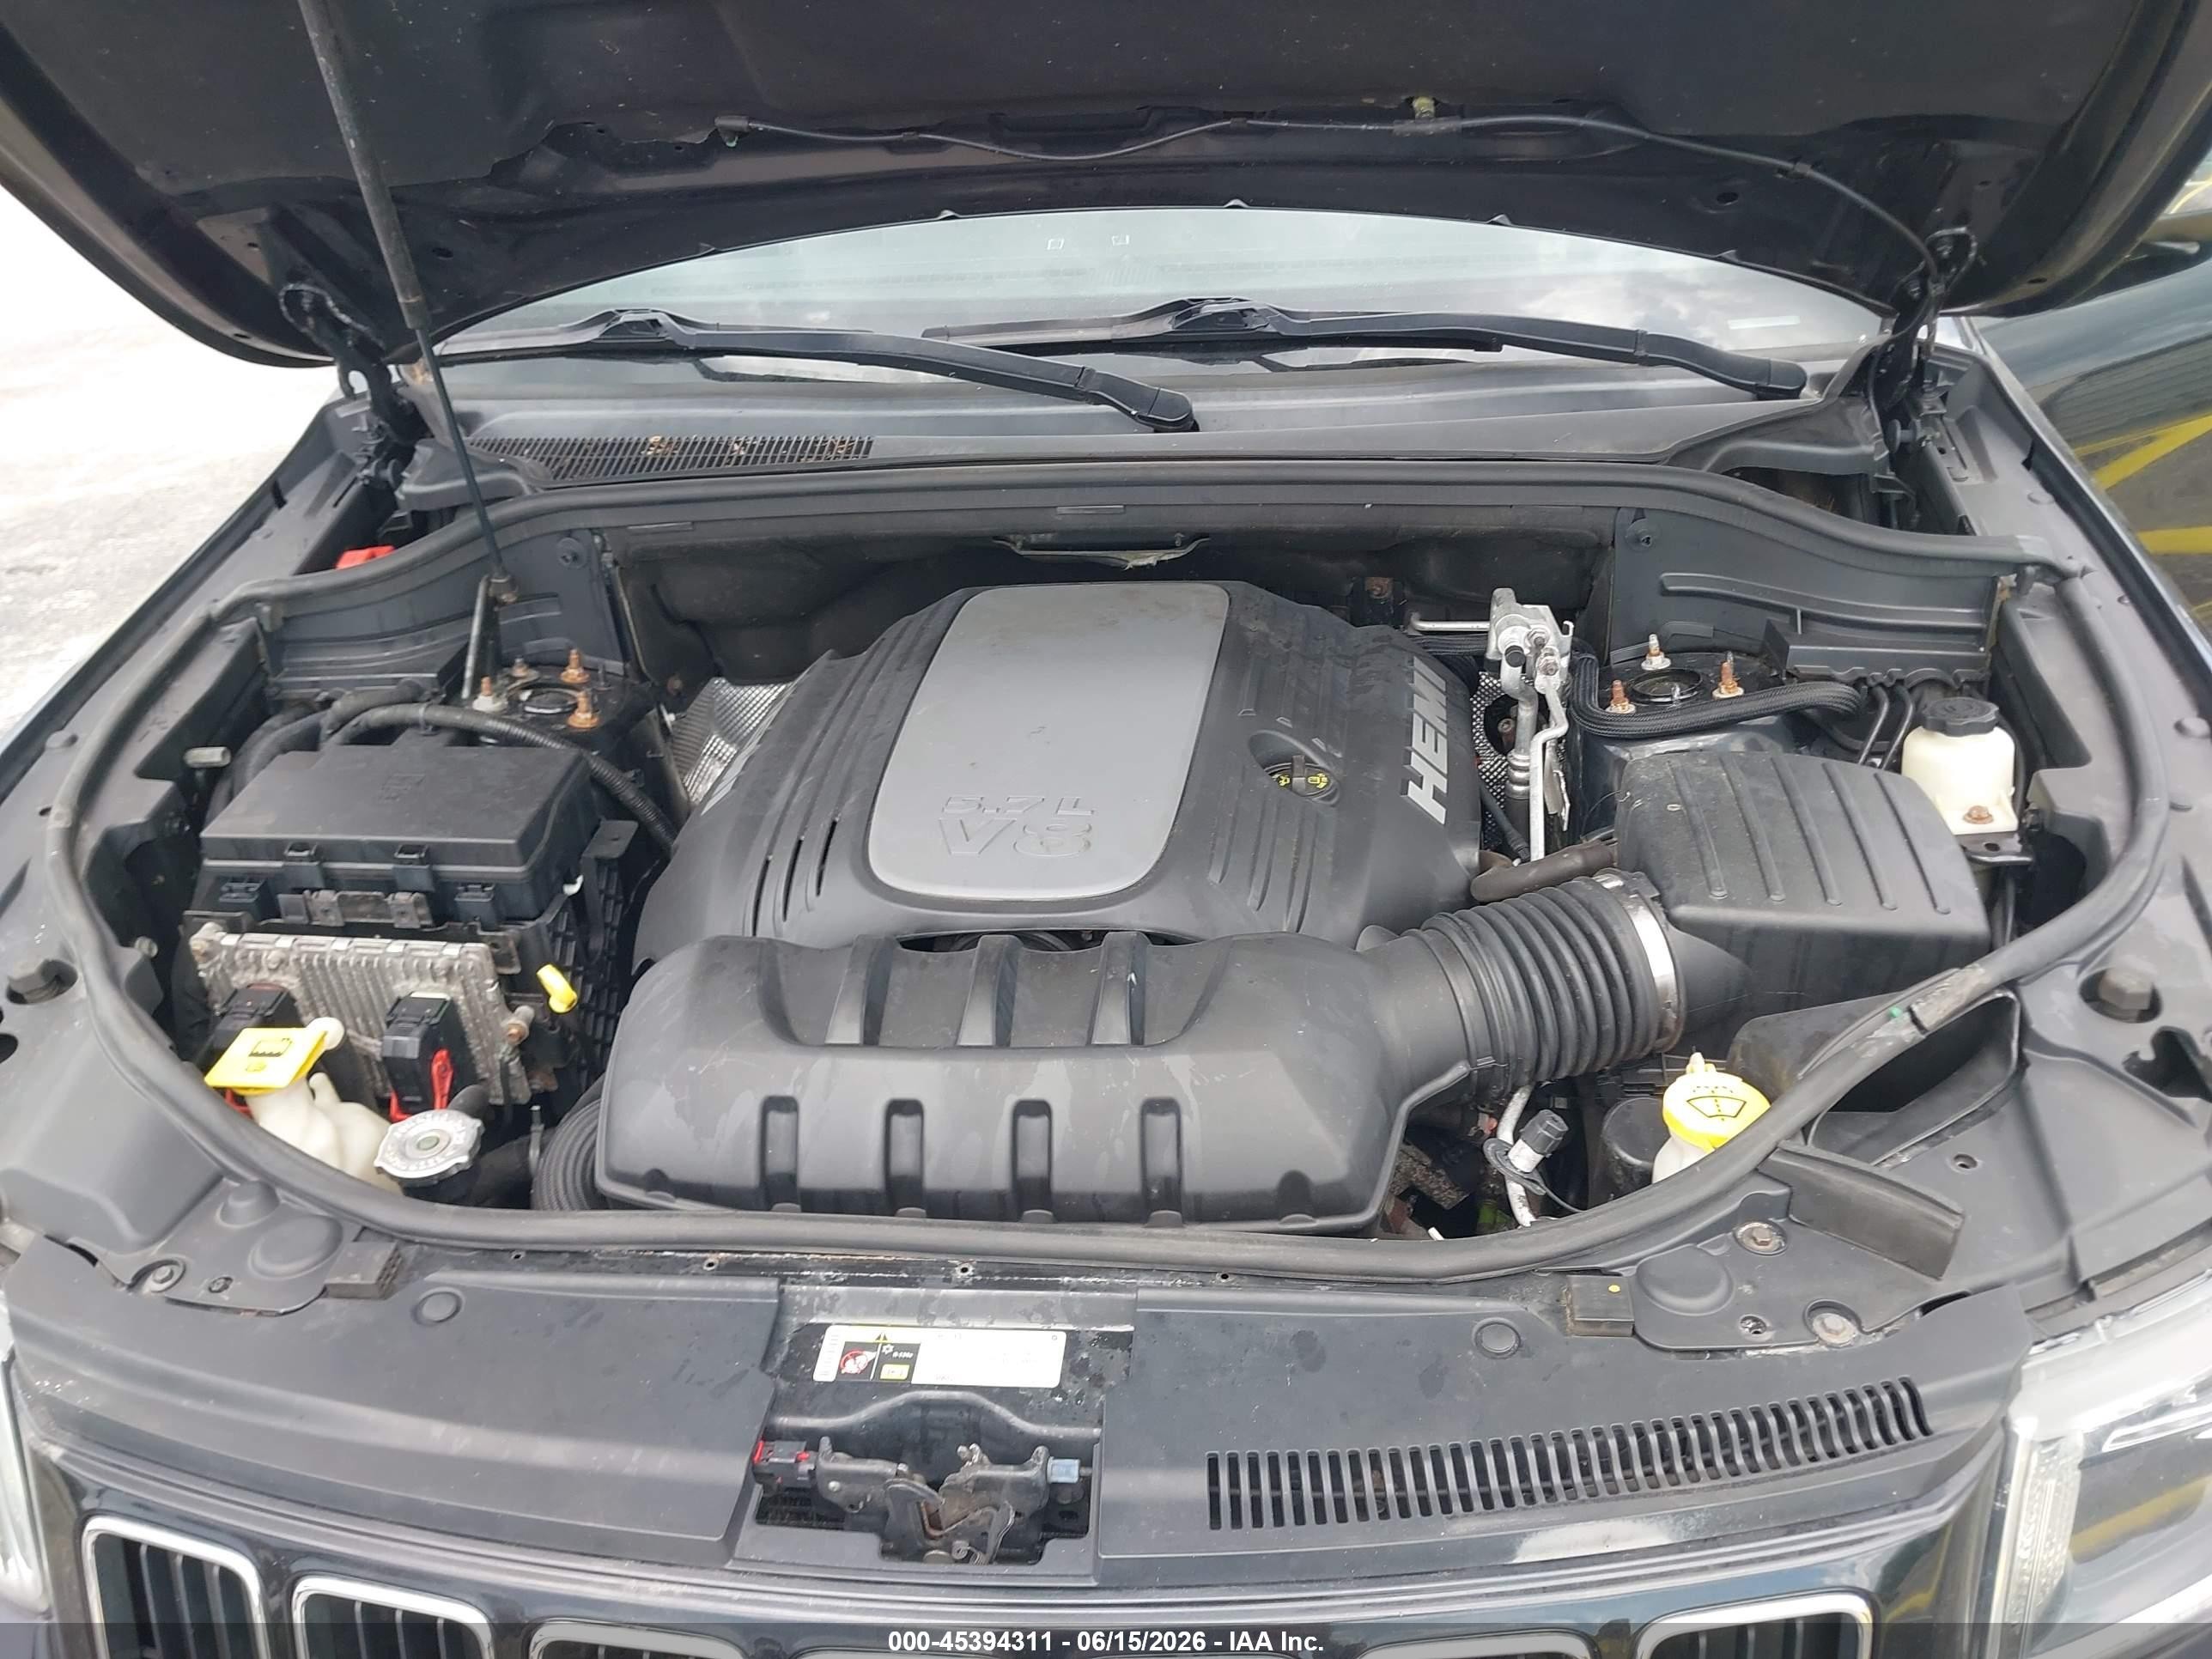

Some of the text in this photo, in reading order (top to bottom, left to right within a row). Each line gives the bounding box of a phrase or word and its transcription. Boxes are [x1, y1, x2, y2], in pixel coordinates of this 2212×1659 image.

[1406, 654, 1449, 826] HEMI
[942, 795, 1096, 817] 5.7L
[938, 817, 1094, 858] V8
